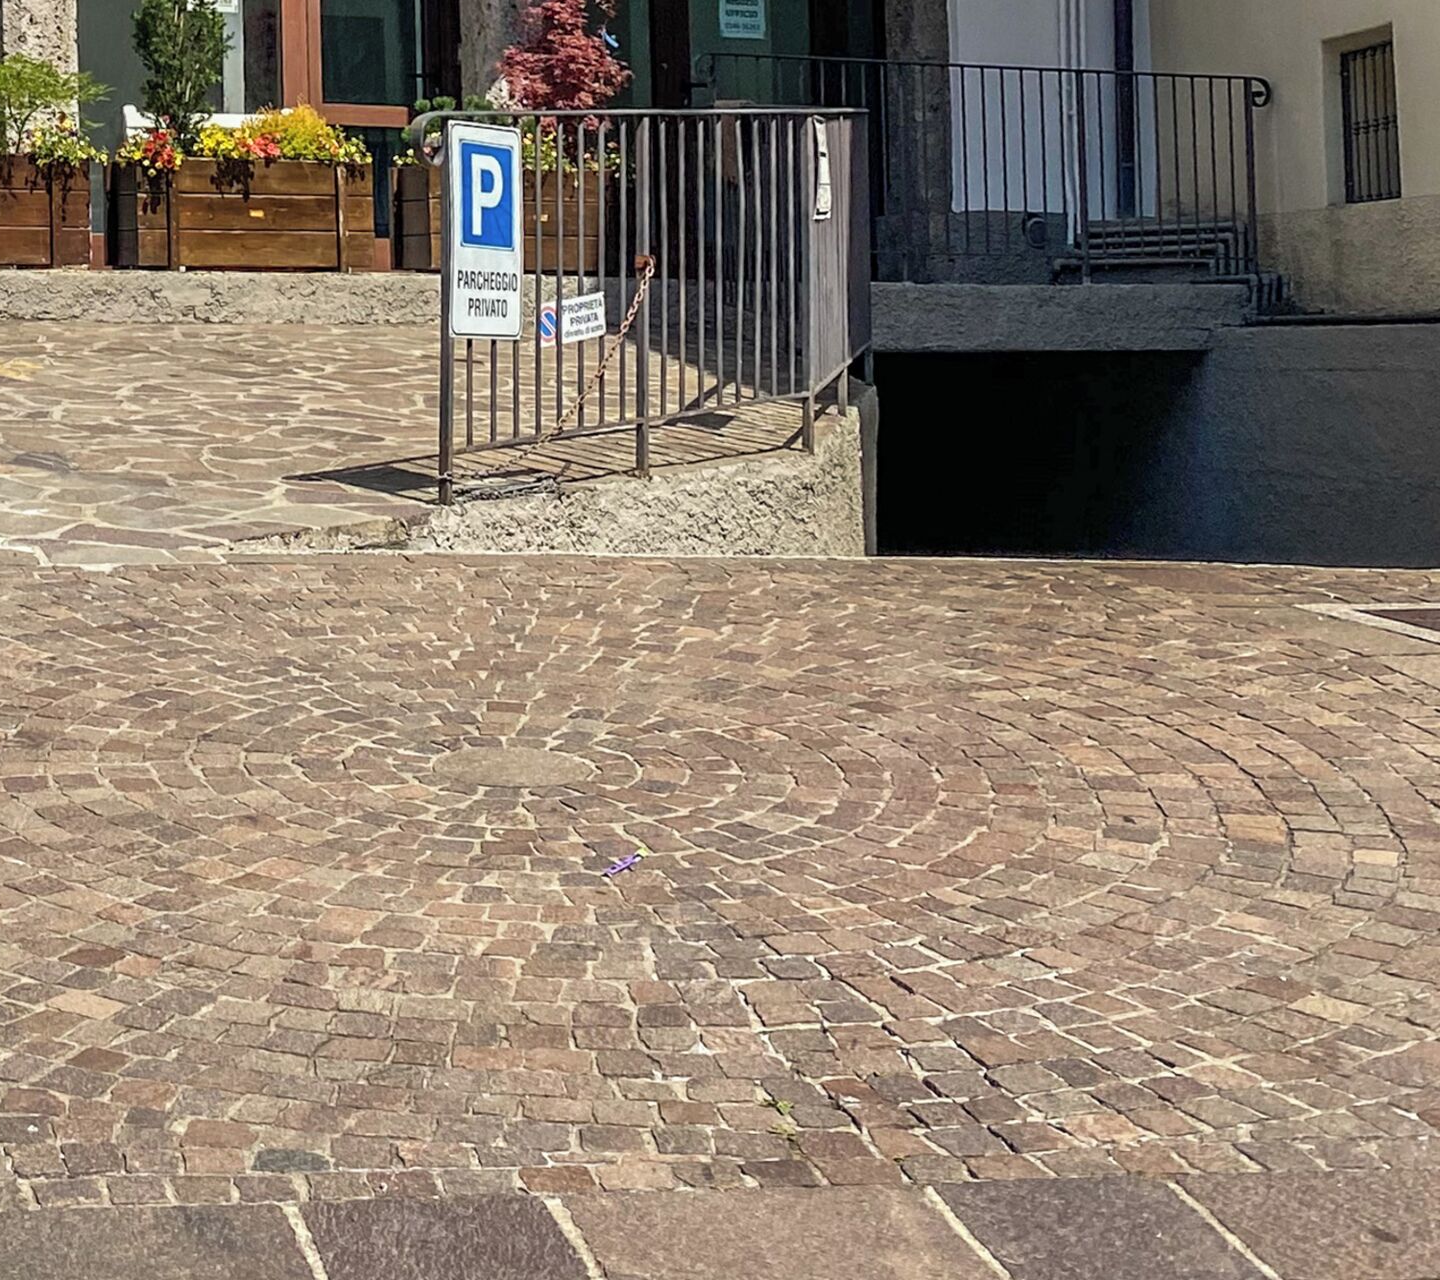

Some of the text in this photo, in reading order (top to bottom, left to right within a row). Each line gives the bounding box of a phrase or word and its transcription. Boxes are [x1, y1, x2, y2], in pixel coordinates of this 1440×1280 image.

[471, 152, 504, 237] P
[457, 269, 518, 293] PARCHEGGIO
[467, 297, 508, 319] PRIVATO
[570, 312, 599, 327] PRIVATA
